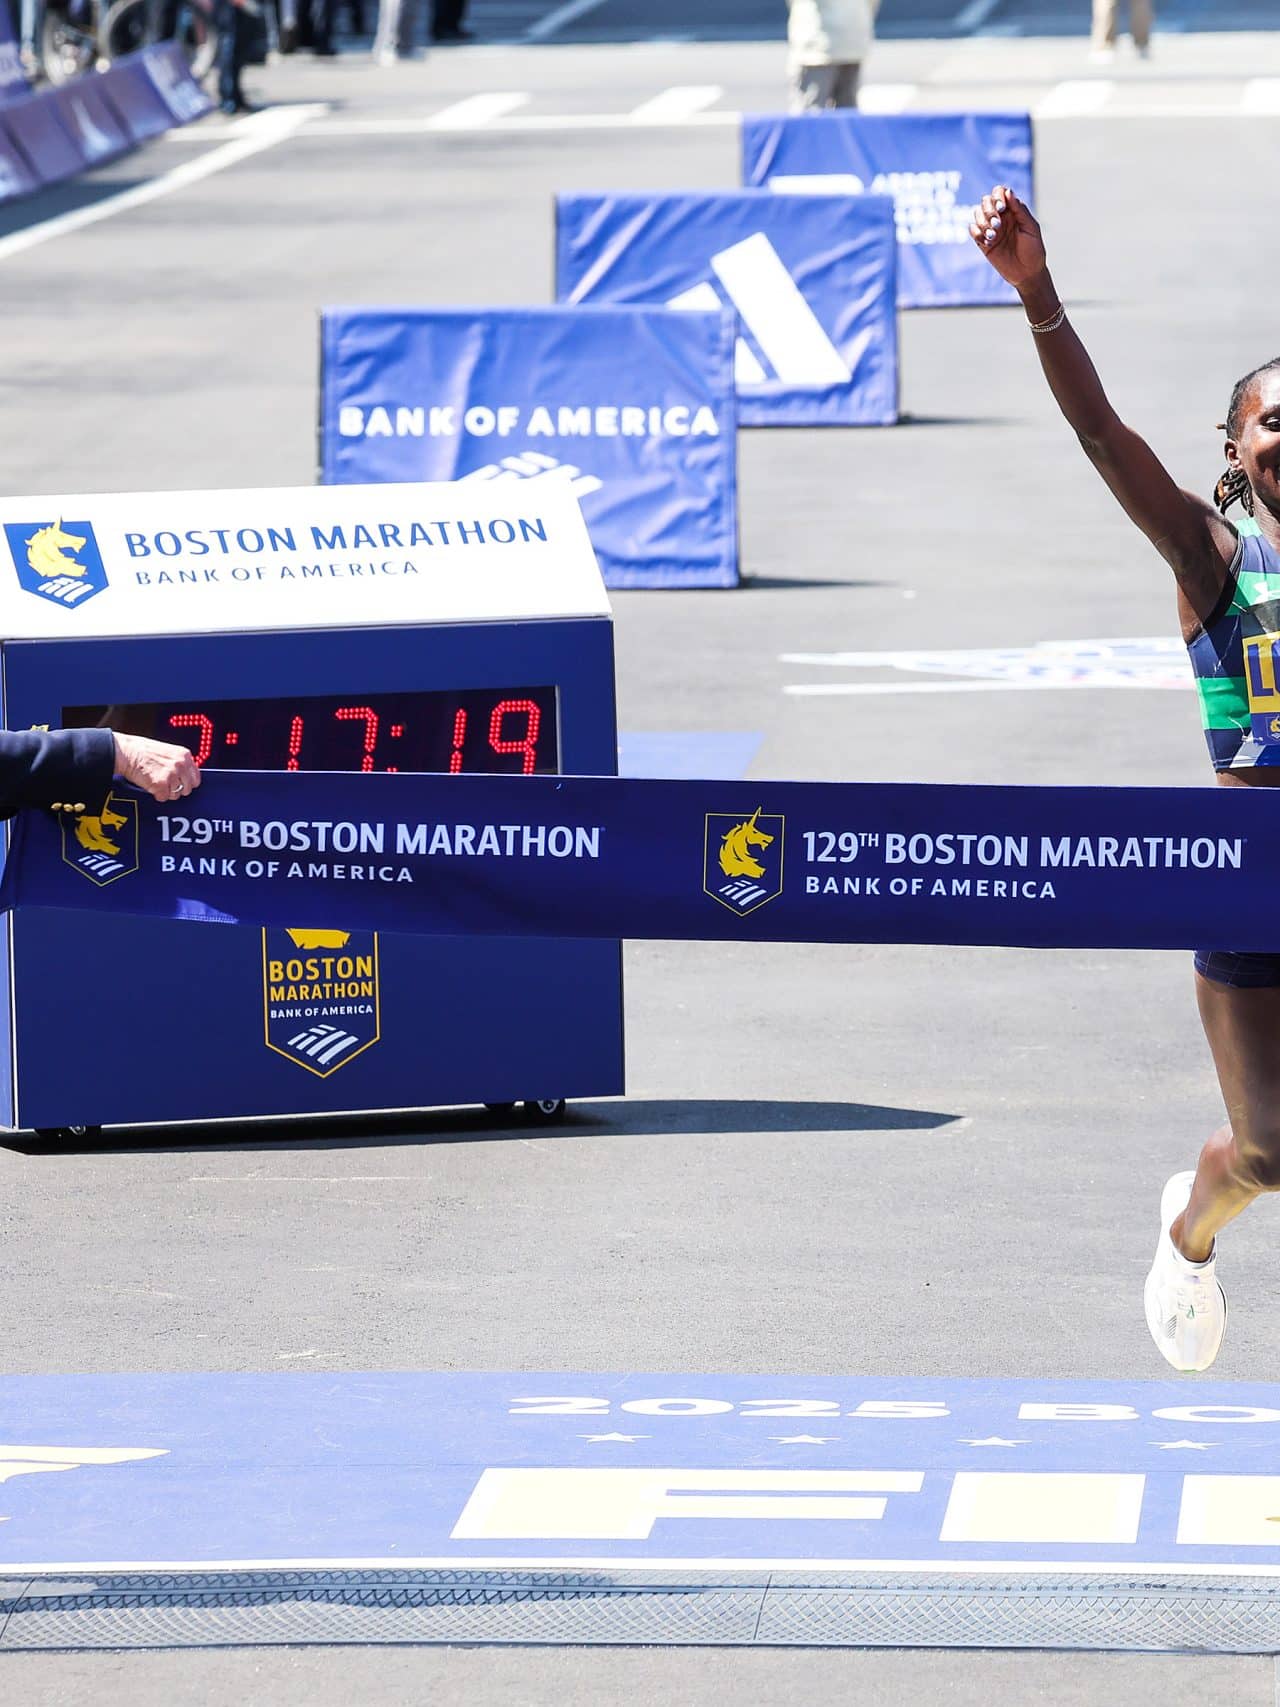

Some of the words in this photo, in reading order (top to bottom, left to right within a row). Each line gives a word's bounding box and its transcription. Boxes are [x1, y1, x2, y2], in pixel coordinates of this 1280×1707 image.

[338, 407, 455, 437] BANK
[465, 407, 518, 436] OF
[527, 406, 719, 437] AMERICA
[125, 528, 296, 557] BOSTON
[311, 519, 547, 549] MARATHON
[135, 568, 220, 586] BANK
[231, 565, 267, 582] OF
[280, 561, 419, 581] AMERICA
[157, 817, 232, 843] 129TH
[240, 822, 384, 852] BOSTON
[397, 824, 599, 857] MARATHON
[803, 832, 878, 862] 129TH
[886, 834, 1027, 866] BOSTON
[1041, 837, 1241, 868] MARATHON
[162, 856, 235, 876] BANK
[246, 861, 279, 877] OF
[288, 863, 412, 882] AMERICA
[807, 877, 880, 894] BANK
[890, 879, 923, 895] OF
[931, 879, 1055, 898] AMERICA
[269, 955, 373, 983] BOSTON
[269, 980, 373, 1002] MARATHON
[271, 1009, 301, 1018] BANK
[305, 1008, 318, 1016] OF
[322, 1005, 372, 1015] AMERICA
[509, 1397, 950, 1417] 2025
